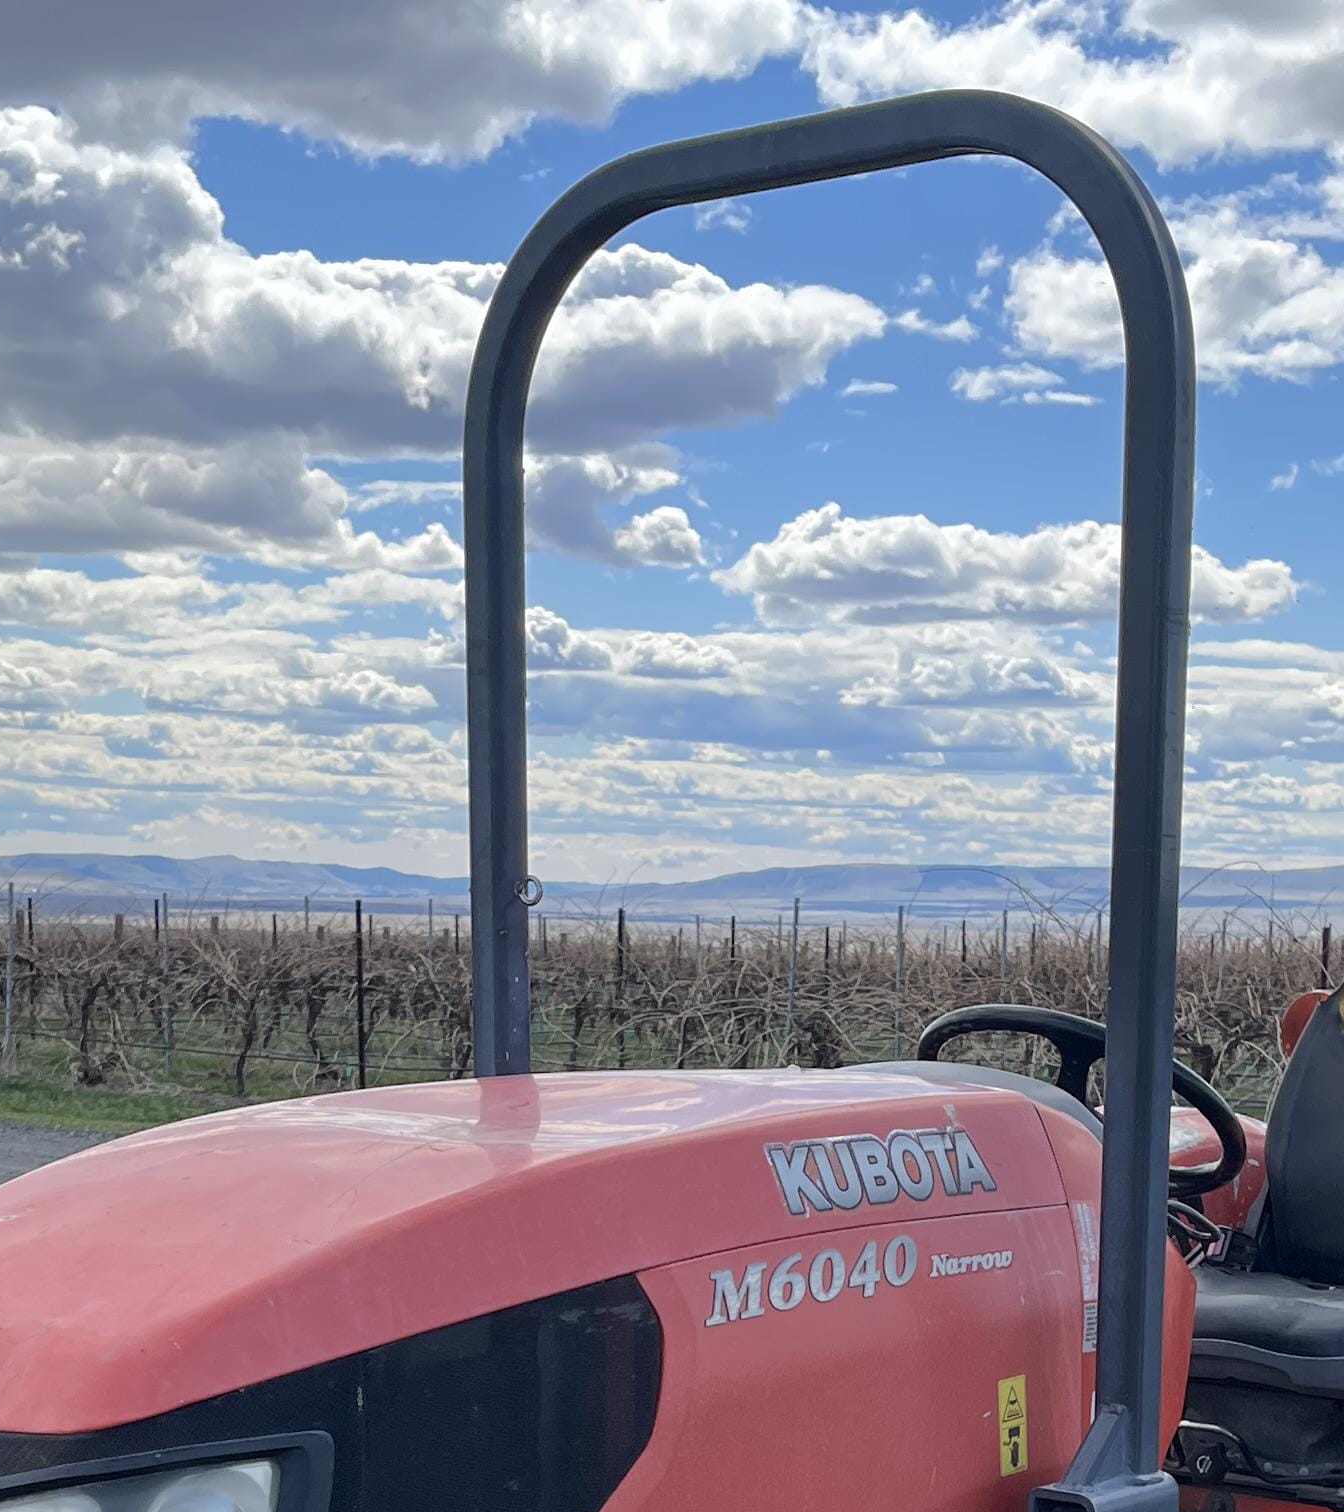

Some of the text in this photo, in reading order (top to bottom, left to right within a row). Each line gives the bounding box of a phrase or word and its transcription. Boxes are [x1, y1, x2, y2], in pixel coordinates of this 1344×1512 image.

[768, 1130, 997, 1215] KUBOTA
[705, 1235, 918, 1327] M6040
[930, 1249, 1013, 1278] Narrow
